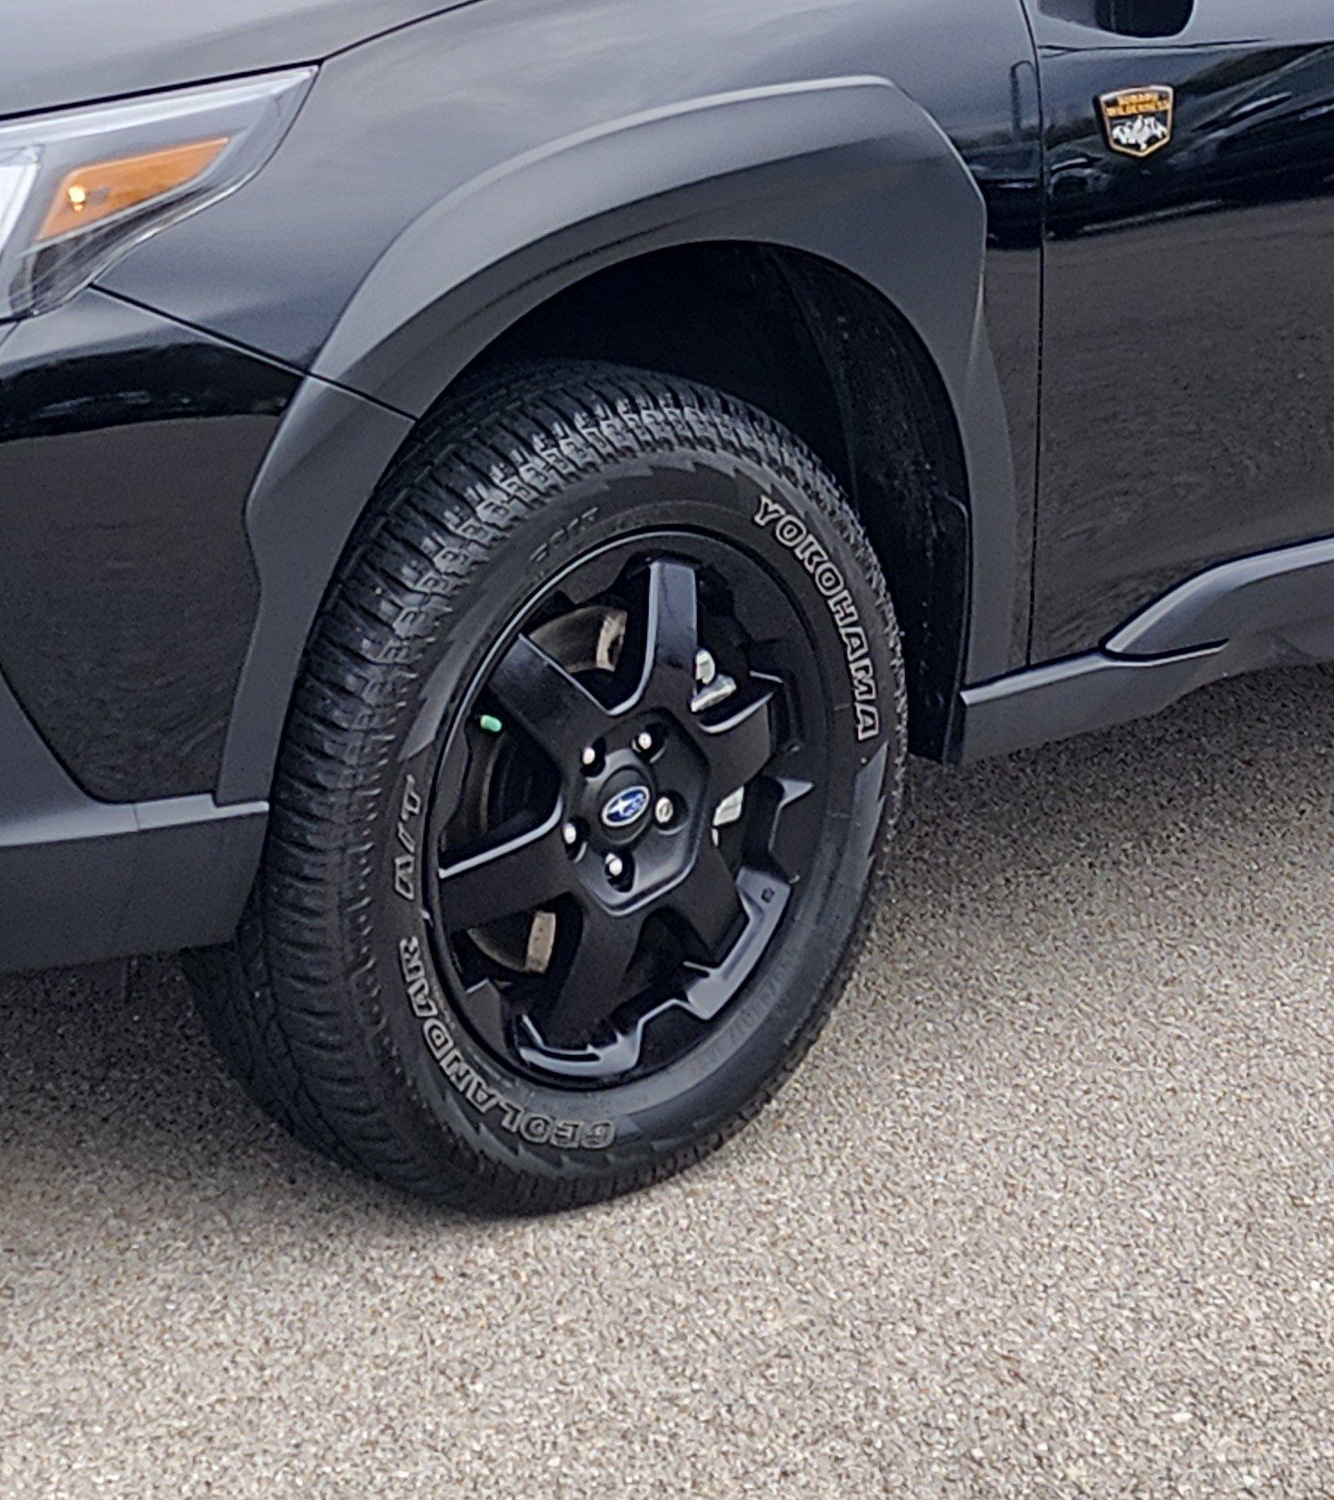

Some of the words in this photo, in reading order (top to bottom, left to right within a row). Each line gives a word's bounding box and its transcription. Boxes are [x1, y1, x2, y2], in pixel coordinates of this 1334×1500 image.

[754, 493, 880, 742] YOKOHAMA
[393, 773, 423, 902] A/T
[398, 935, 617, 1150] GEOLANDAR
